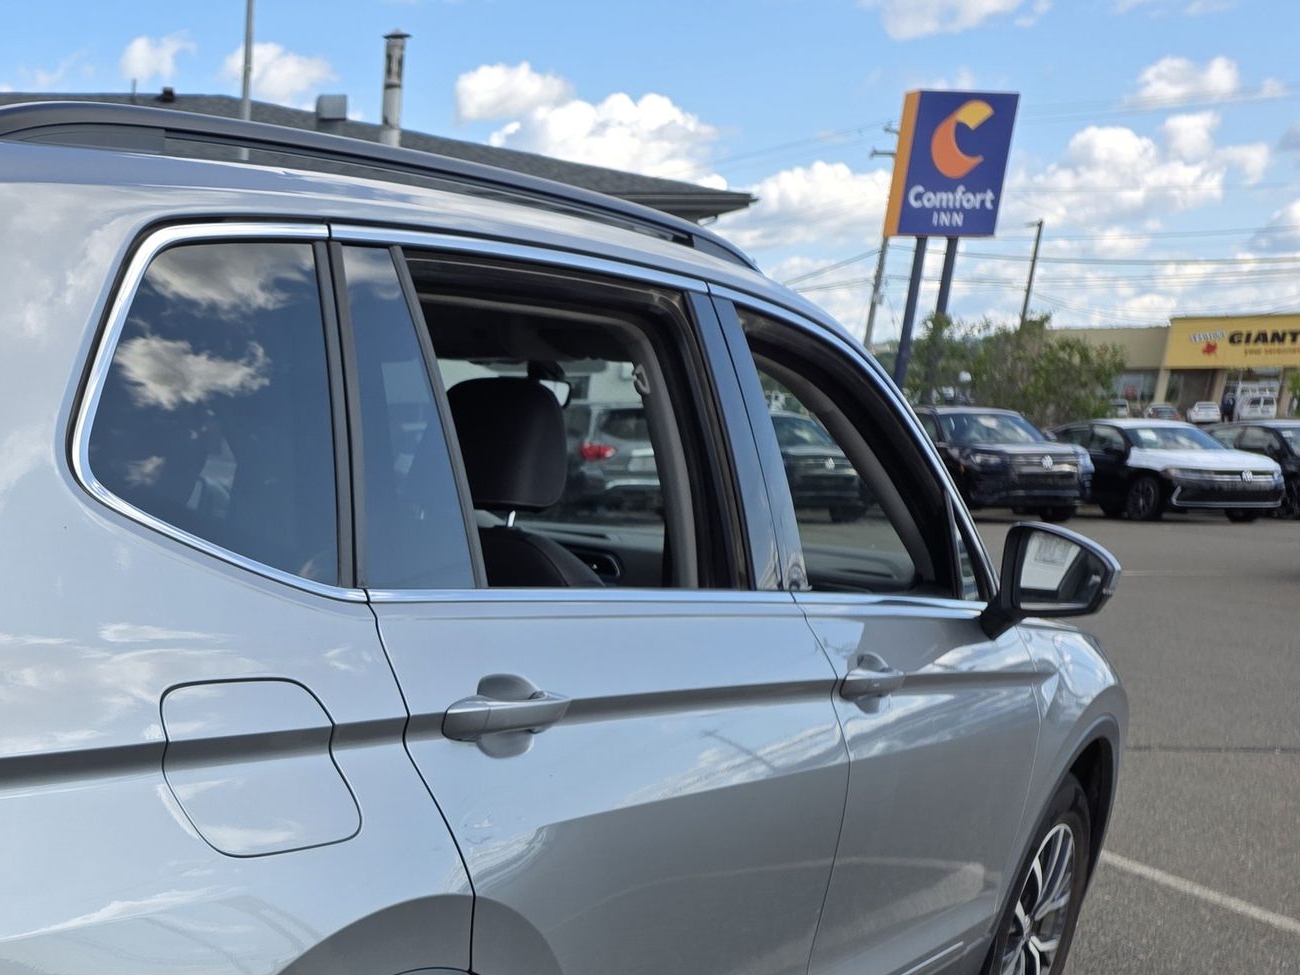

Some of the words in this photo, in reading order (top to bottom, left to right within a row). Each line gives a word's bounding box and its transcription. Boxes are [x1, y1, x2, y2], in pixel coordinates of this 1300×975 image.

[908, 184, 995, 210] Comfort
[932, 210, 964, 227] INN
[1228, 330, 1300, 345] GIANT
